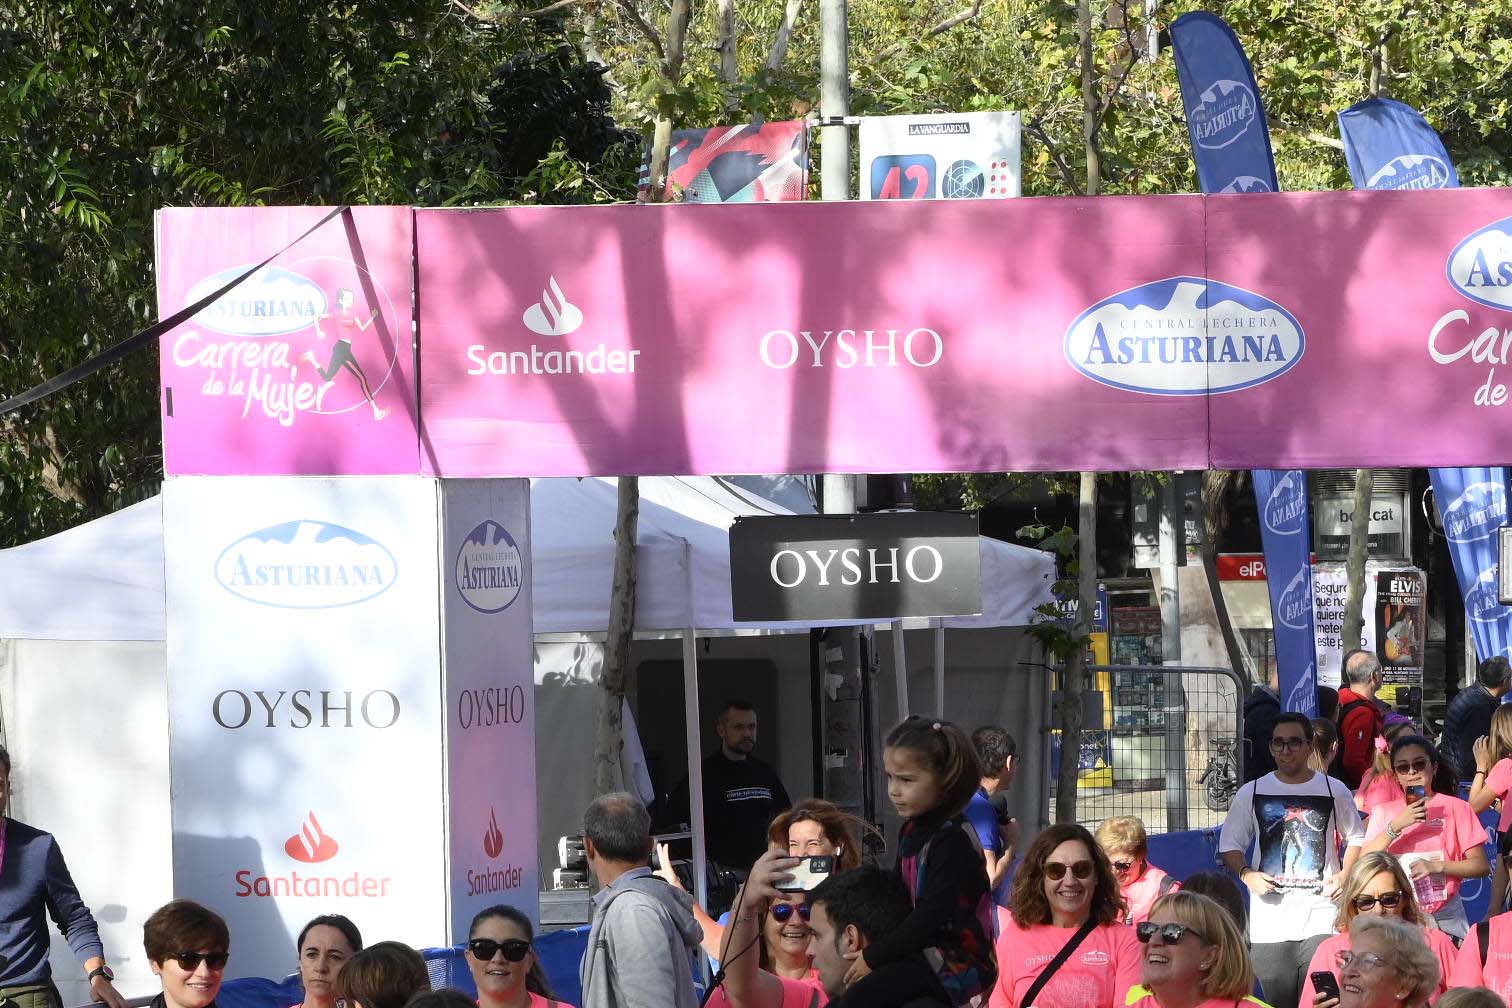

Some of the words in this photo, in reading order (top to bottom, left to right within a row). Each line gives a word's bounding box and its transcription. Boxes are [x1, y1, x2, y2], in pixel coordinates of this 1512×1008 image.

[1120, 318, 1194, 329] CENTRAL
[1203, 316, 1278, 329] LECHERA
[173, 331, 291, 368] Carrera
[467, 344, 640, 375] Santander
[760, 327, 943, 369] OYSHO
[1084, 321, 1286, 364] ASTURIANA
[203, 371, 223, 395] de
[228, 373, 245, 396] la
[242, 367, 335, 426] Mujer
[1473, 368, 1508, 406] de
[230, 553, 384, 587] ASTURIANA
[461, 557, 519, 590] ASTURIANA
[770, 544, 943, 588] OYSHO
[1316, 597, 1331, 610] que
[1390, 580, 1420, 593] ELVIS
[1318, 636, 1335, 647] este
[212, 690, 400, 729] OYSHO
[459, 685, 525, 730] OYSHO
[235, 871, 391, 897] Santander
[467, 865, 523, 897] Santander
